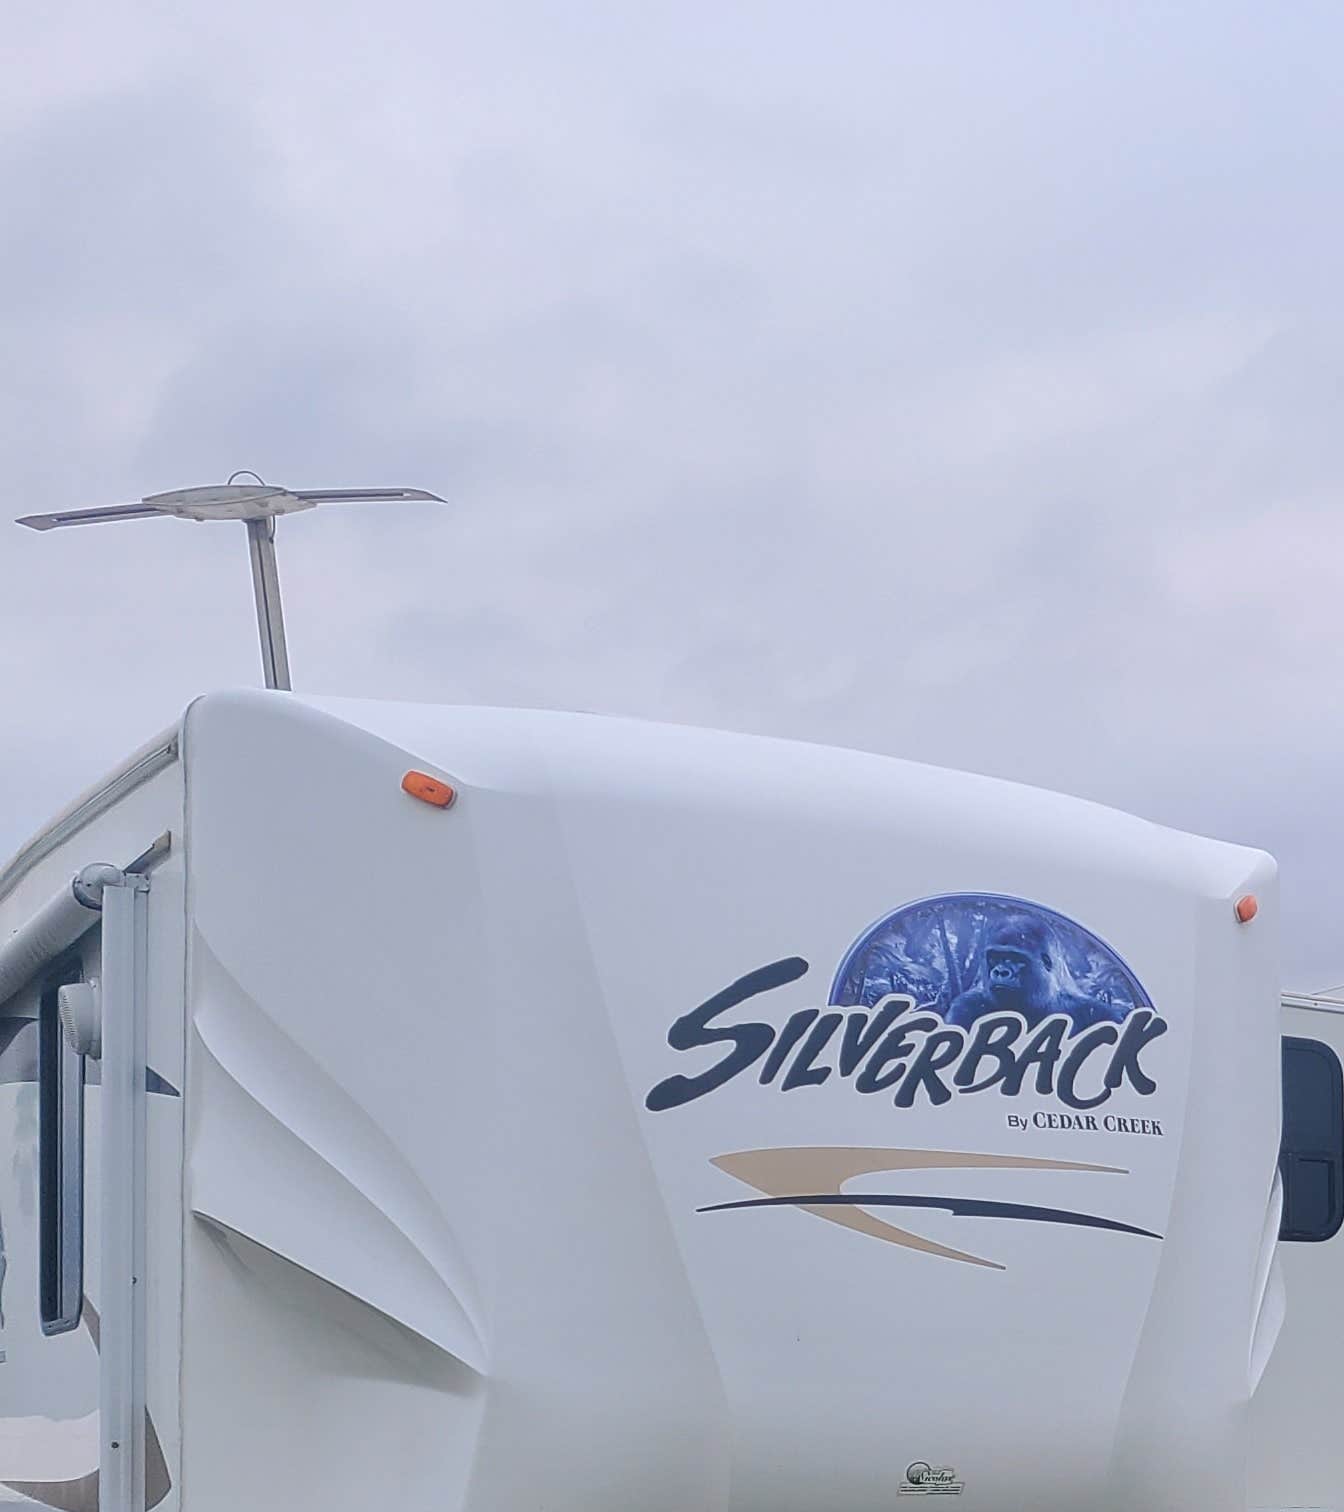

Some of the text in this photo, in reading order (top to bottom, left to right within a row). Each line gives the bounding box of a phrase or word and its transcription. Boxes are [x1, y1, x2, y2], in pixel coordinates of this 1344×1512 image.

[646, 956, 1168, 1111] SILVERBACK
[1008, 1112, 1164, 1136] By CEDAR CREEK
